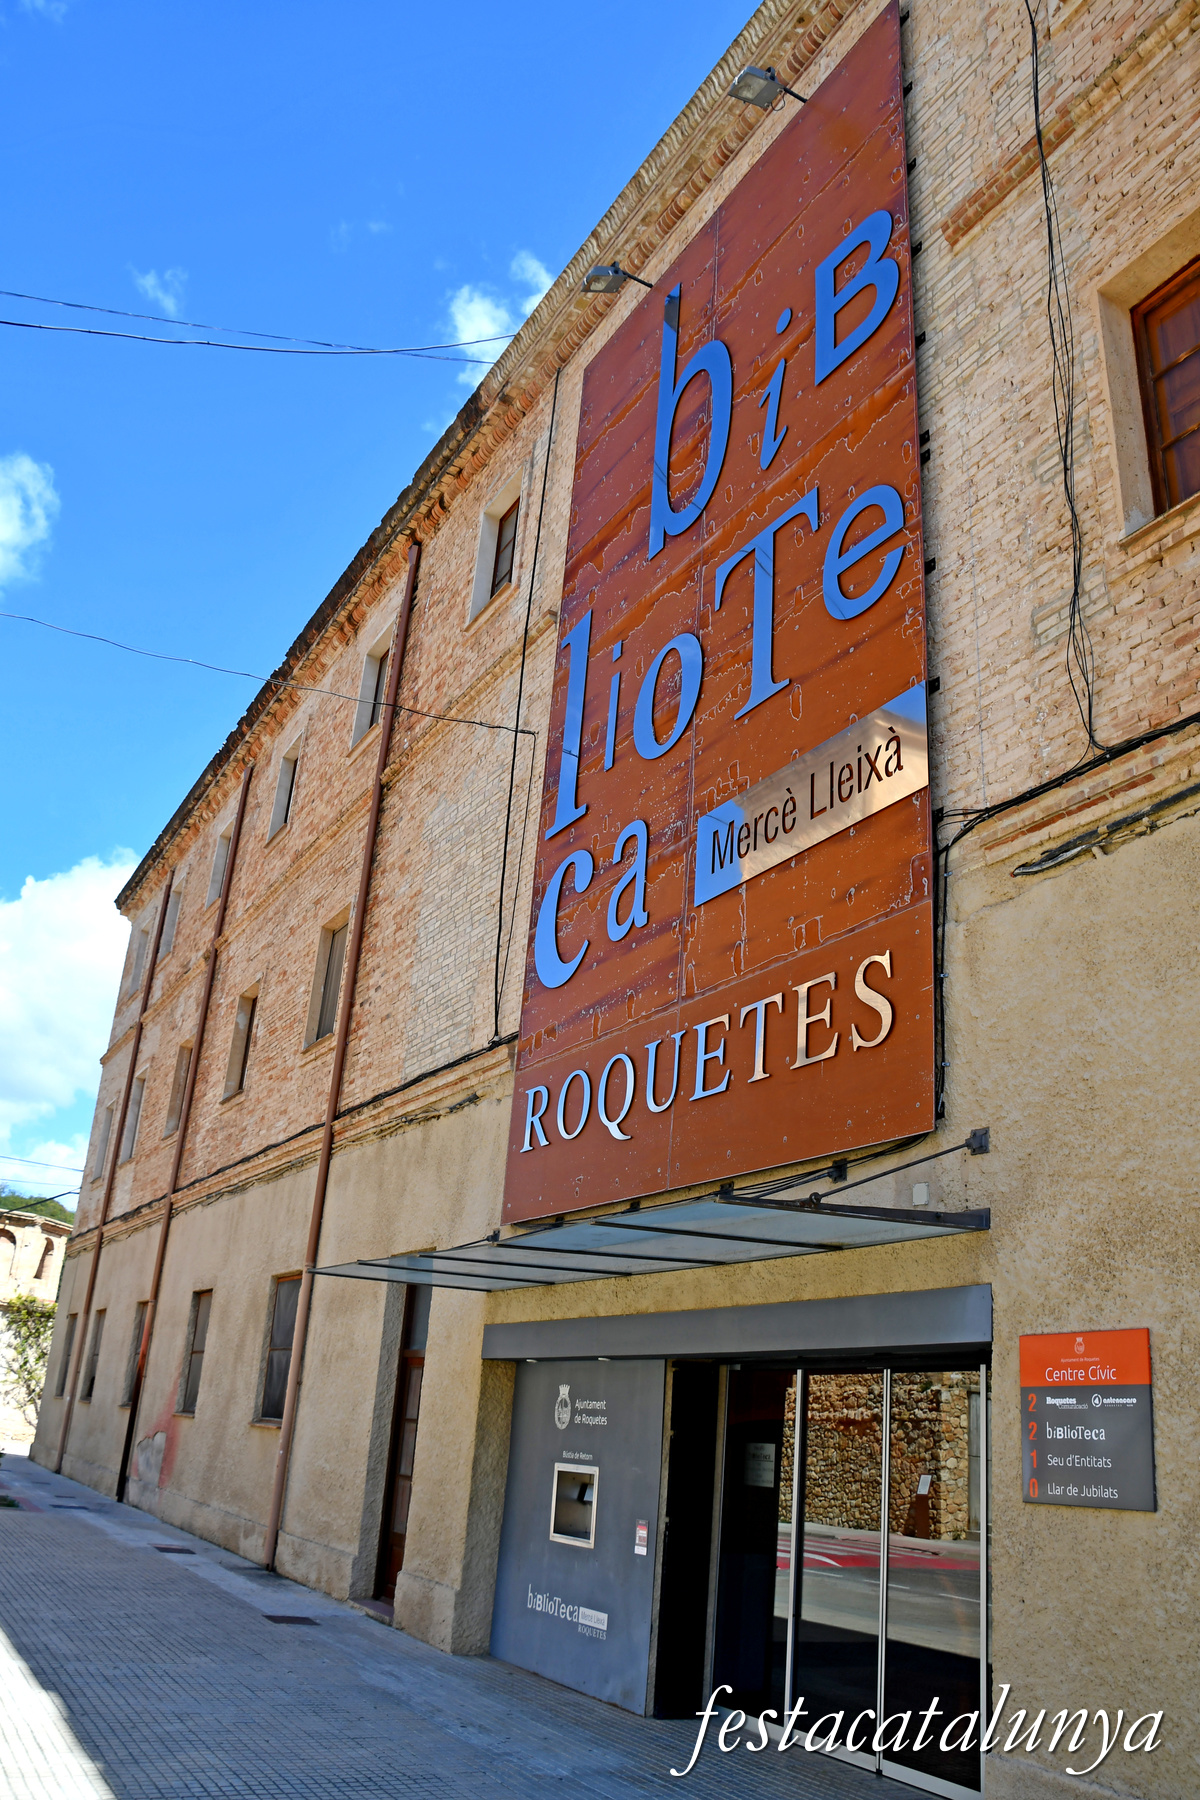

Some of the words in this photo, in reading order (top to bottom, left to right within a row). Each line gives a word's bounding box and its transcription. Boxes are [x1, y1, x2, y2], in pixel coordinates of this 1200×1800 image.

[711, 787, 797, 875] Mercè
[810, 726, 904, 820] Lleixà
[534, 819, 650, 989] ca
[520, 949, 893, 1153] ROQUETES
[1045, 1367, 1086, 1381] Centre
[1088, 1365, 1117, 1380] Cívic
[575, 1399, 606, 1411] Ajuntament
[1028, 1393, 1037, 1412] 2
[1046, 1396, 1077, 1407] Roquetes
[574, 1413, 581, 1424] de
[582, 1413, 608, 1427] Roquetes
[1028, 1421, 1037, 1440] 2
[1046, 1421, 1105, 1440] biBlioTeca
[575, 1451, 580, 1460] de
[1030, 1449, 1037, 1468] 1
[1047, 1454, 1064, 1466] Seu
[1066, 1454, 1112, 1468] d'Entitats
[1029, 1478, 1038, 1498] 0
[1047, 1482, 1064, 1495] Llar
[1066, 1483, 1079, 1496] de
[1081, 1485, 1119, 1499] Jubilats
[578, 1623, 607, 1640] ROQUETES
